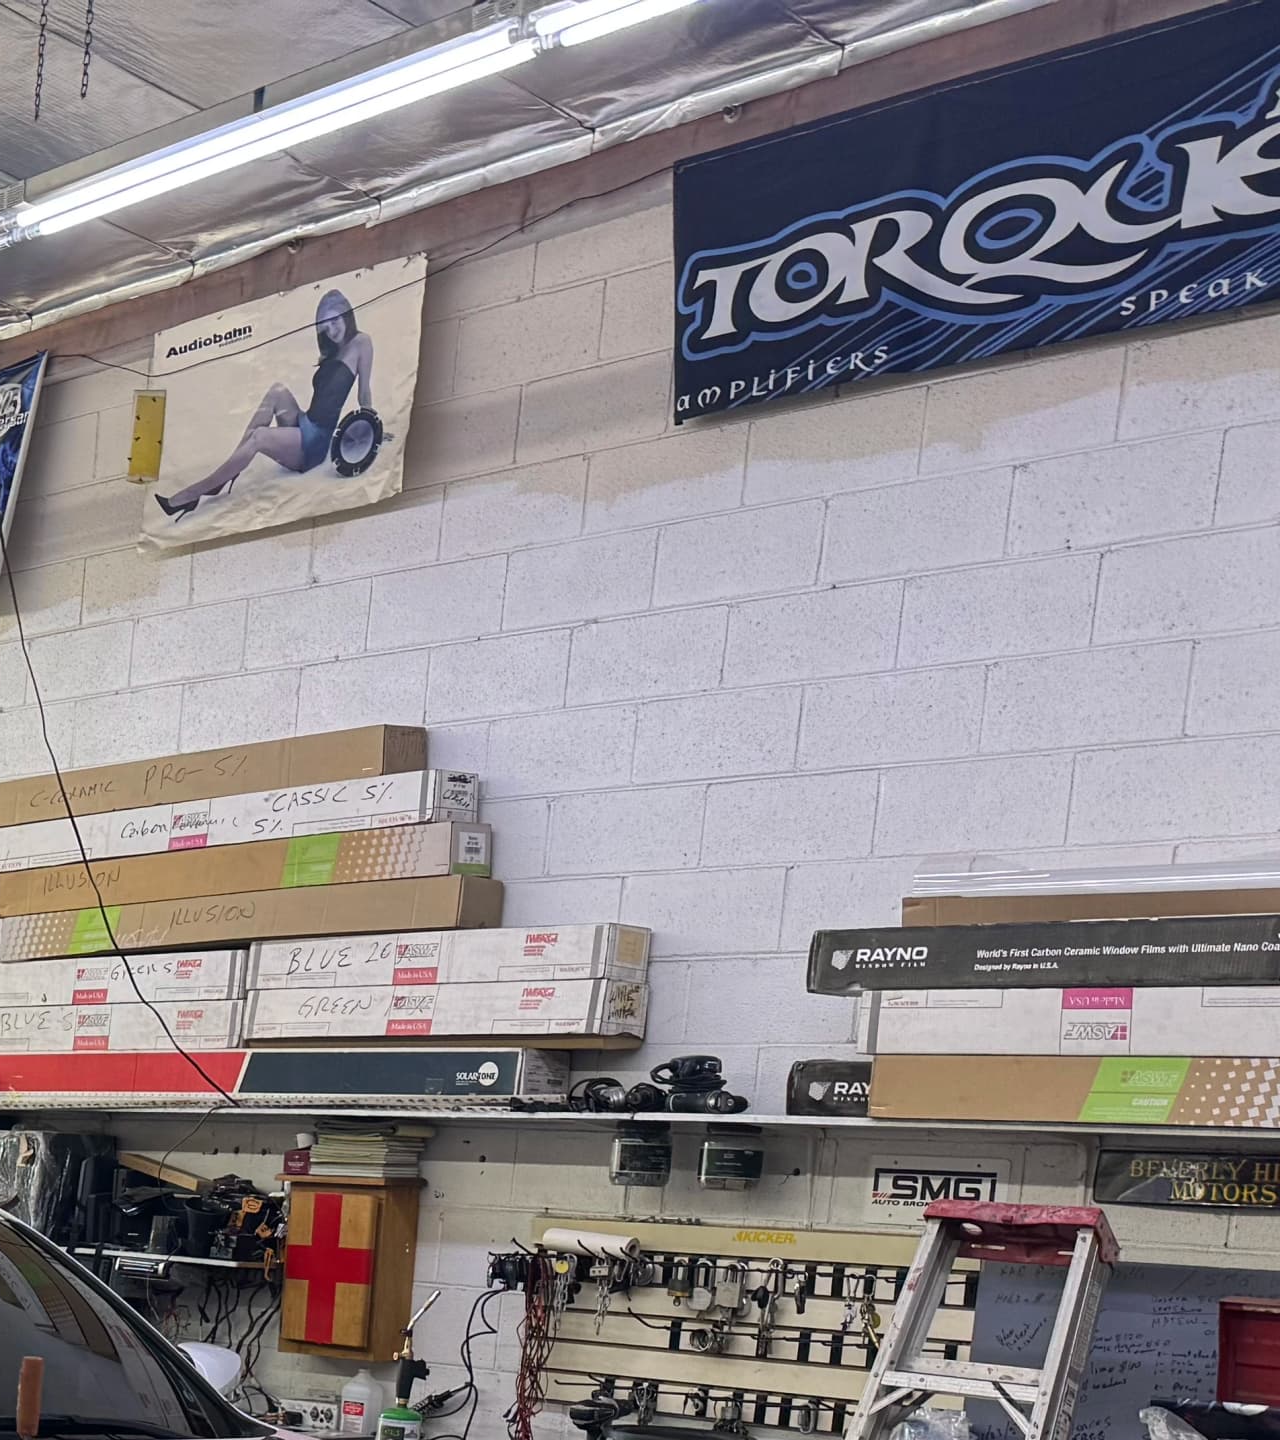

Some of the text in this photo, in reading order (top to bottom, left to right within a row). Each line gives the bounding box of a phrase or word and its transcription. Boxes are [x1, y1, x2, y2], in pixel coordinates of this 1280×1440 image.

[166, 324, 253, 358] Audiobahn
[856, 946, 929, 962] RAYNO
[976, 948, 1008, 959] World's
[1009, 947, 1030, 958] First
[1032, 946, 1063, 957] Carbon
[1064, 945, 1101, 956] Ceramic
[1102, 945, 1140, 955] Window
[1141, 943, 1166, 954] Films
[1167, 942, 1189, 953] with
[1191, 942, 1232, 953] Ultimate
[1233, 941, 1259, 951] Nano
[287, 946, 353, 975] BLUE
[298, 995, 373, 1018] GREEN
[1069, 995, 1089, 1005] USA
[1102, 996, 1125, 1005] Made
[1, 1010, 53, 1035] BLUE
[1064, 1024, 1117, 1040] ASWF
[1130, 1158, 1245, 1179] BEVERLY
[890, 1176, 984, 1201] SMG
[1170, 1181, 1277, 1202] MOTORS
[870, 1198, 900, 1207] AUTO
[741, 1231, 797, 1245] KICKER
